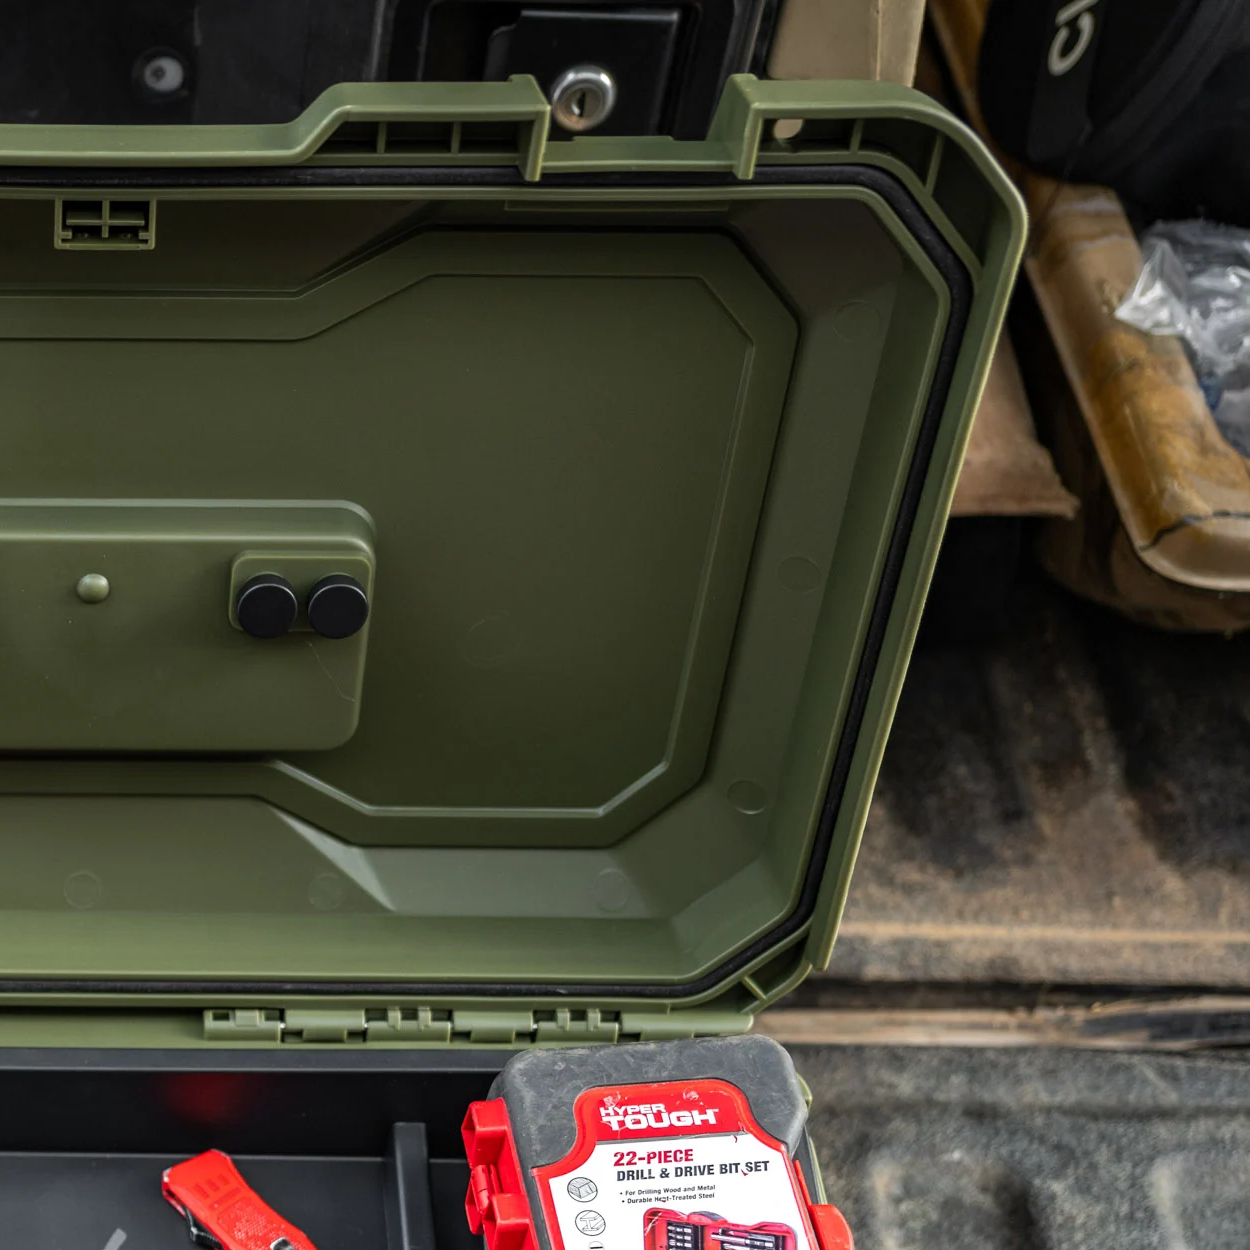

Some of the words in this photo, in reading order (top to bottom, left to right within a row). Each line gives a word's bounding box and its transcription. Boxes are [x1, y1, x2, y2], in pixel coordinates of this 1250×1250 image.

[599, 1103, 666, 1117] HYPER
[602, 1110, 717, 1131] TOUGH
[613, 1149, 694, 1167] 22-PIECE
[617, 1168, 656, 1181] DRILL
[659, 1167, 670, 1178] &
[674, 1164, 715, 1177] DRIVE
[719, 1162, 741, 1174] BIT
[746, 1160, 770, 1172] SET
[638, 1187, 662, 1196] Drilling
[627, 1196, 653, 1204] Durable
